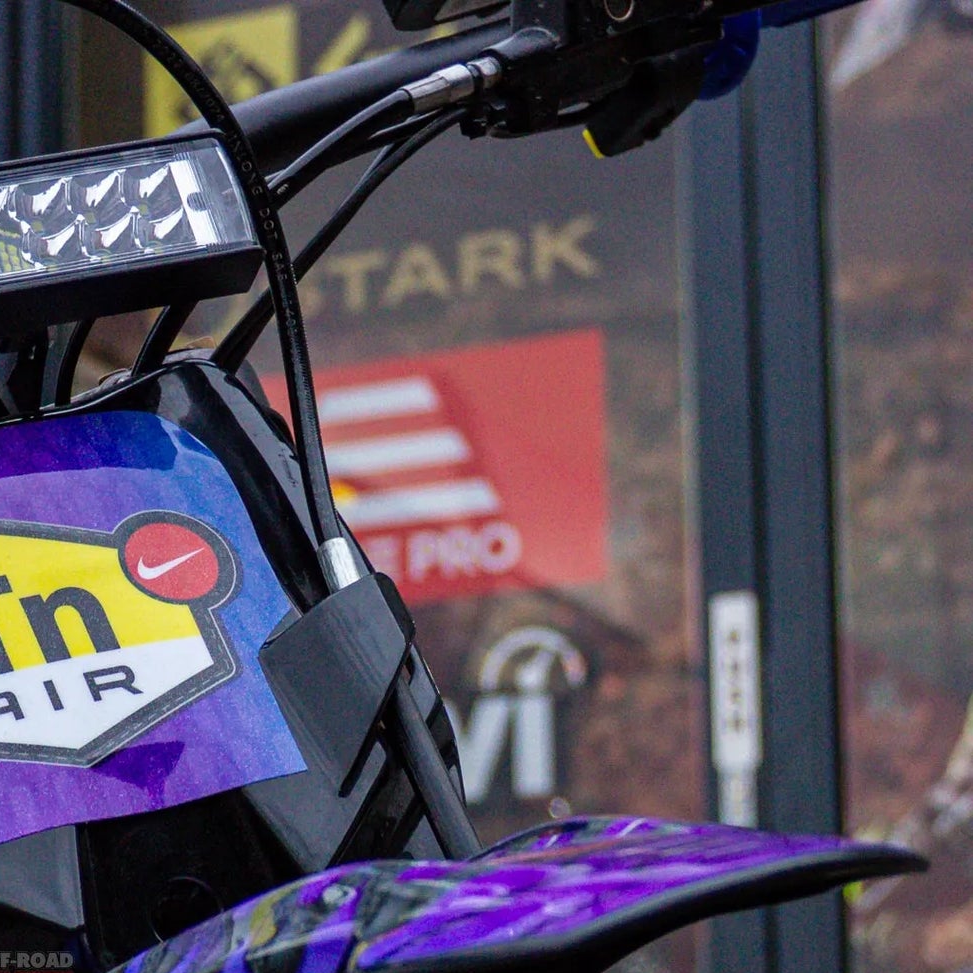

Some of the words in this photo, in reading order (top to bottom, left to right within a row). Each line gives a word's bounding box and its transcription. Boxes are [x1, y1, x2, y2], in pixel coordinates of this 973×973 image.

[259, 207, 277, 240] DOT
[271, 253, 288, 280] SAE
[407, 521, 523, 583] PRO
